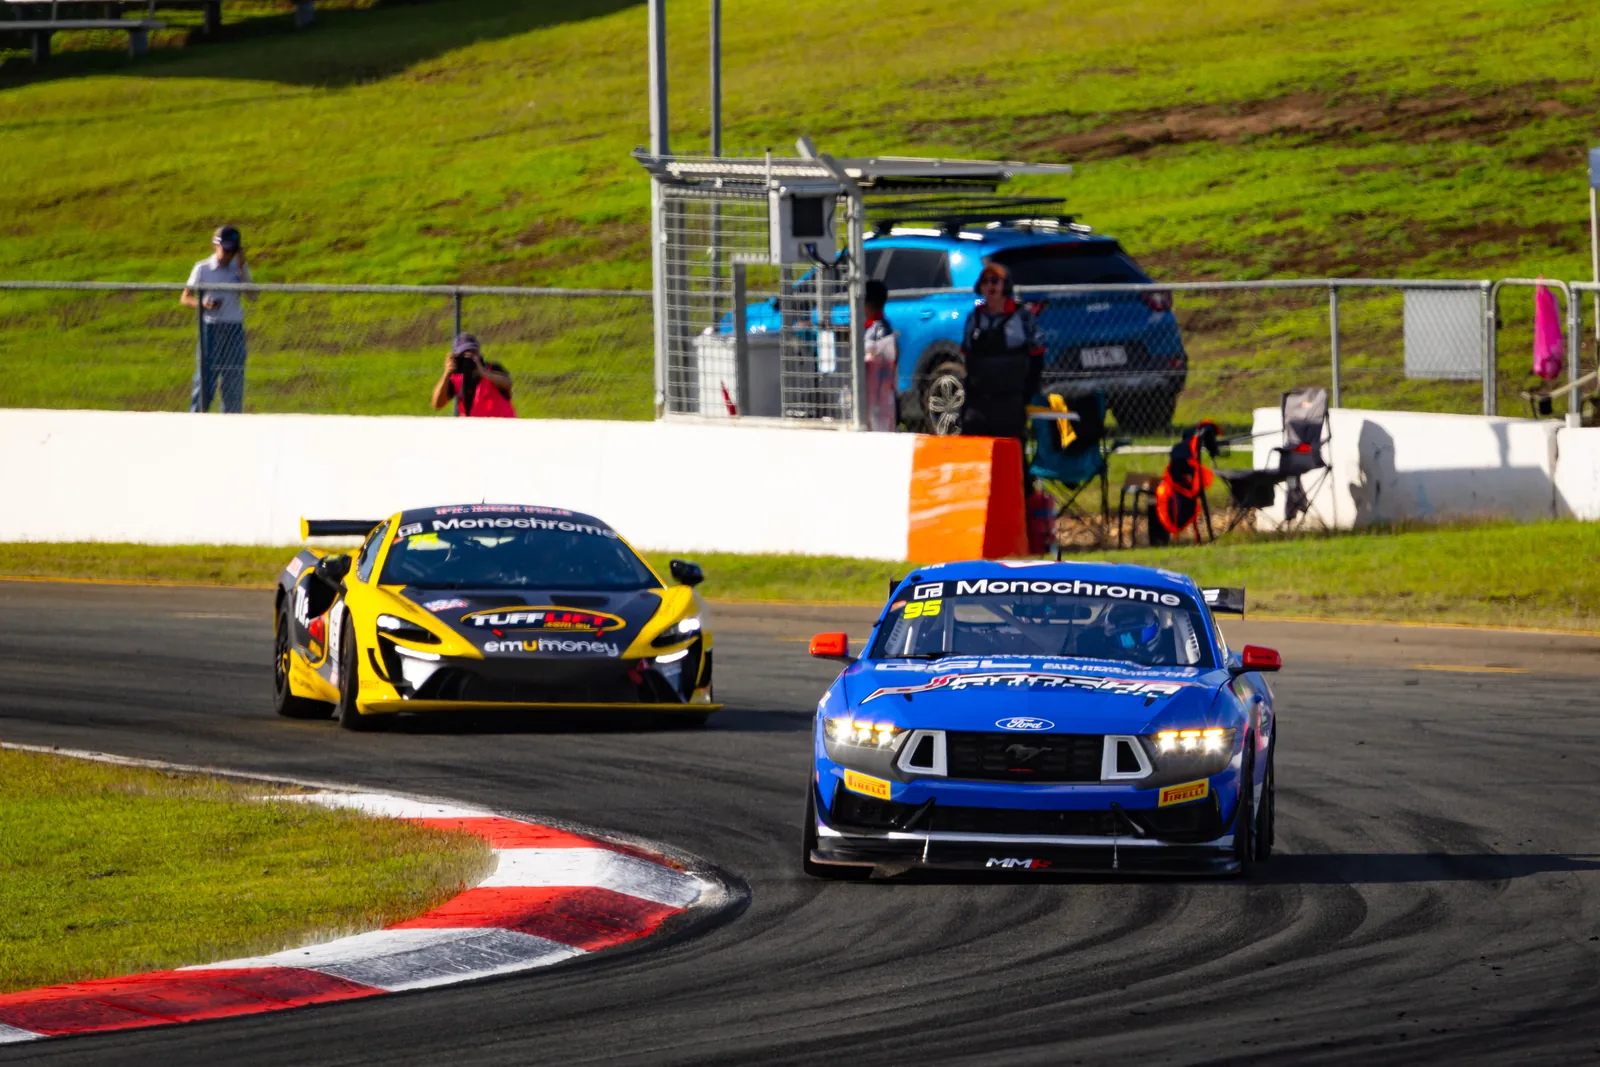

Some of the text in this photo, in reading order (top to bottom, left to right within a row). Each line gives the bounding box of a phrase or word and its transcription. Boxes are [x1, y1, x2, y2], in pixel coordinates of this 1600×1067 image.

[431, 517, 618, 539] Monochrome
[956, 579, 1180, 606] Monochrome
[904, 600, 943, 619] 95
[1005, 718, 1044, 730] Ford
[847, 774, 886, 796] PIRELLI
[1162, 783, 1205, 803] PIRELLI
